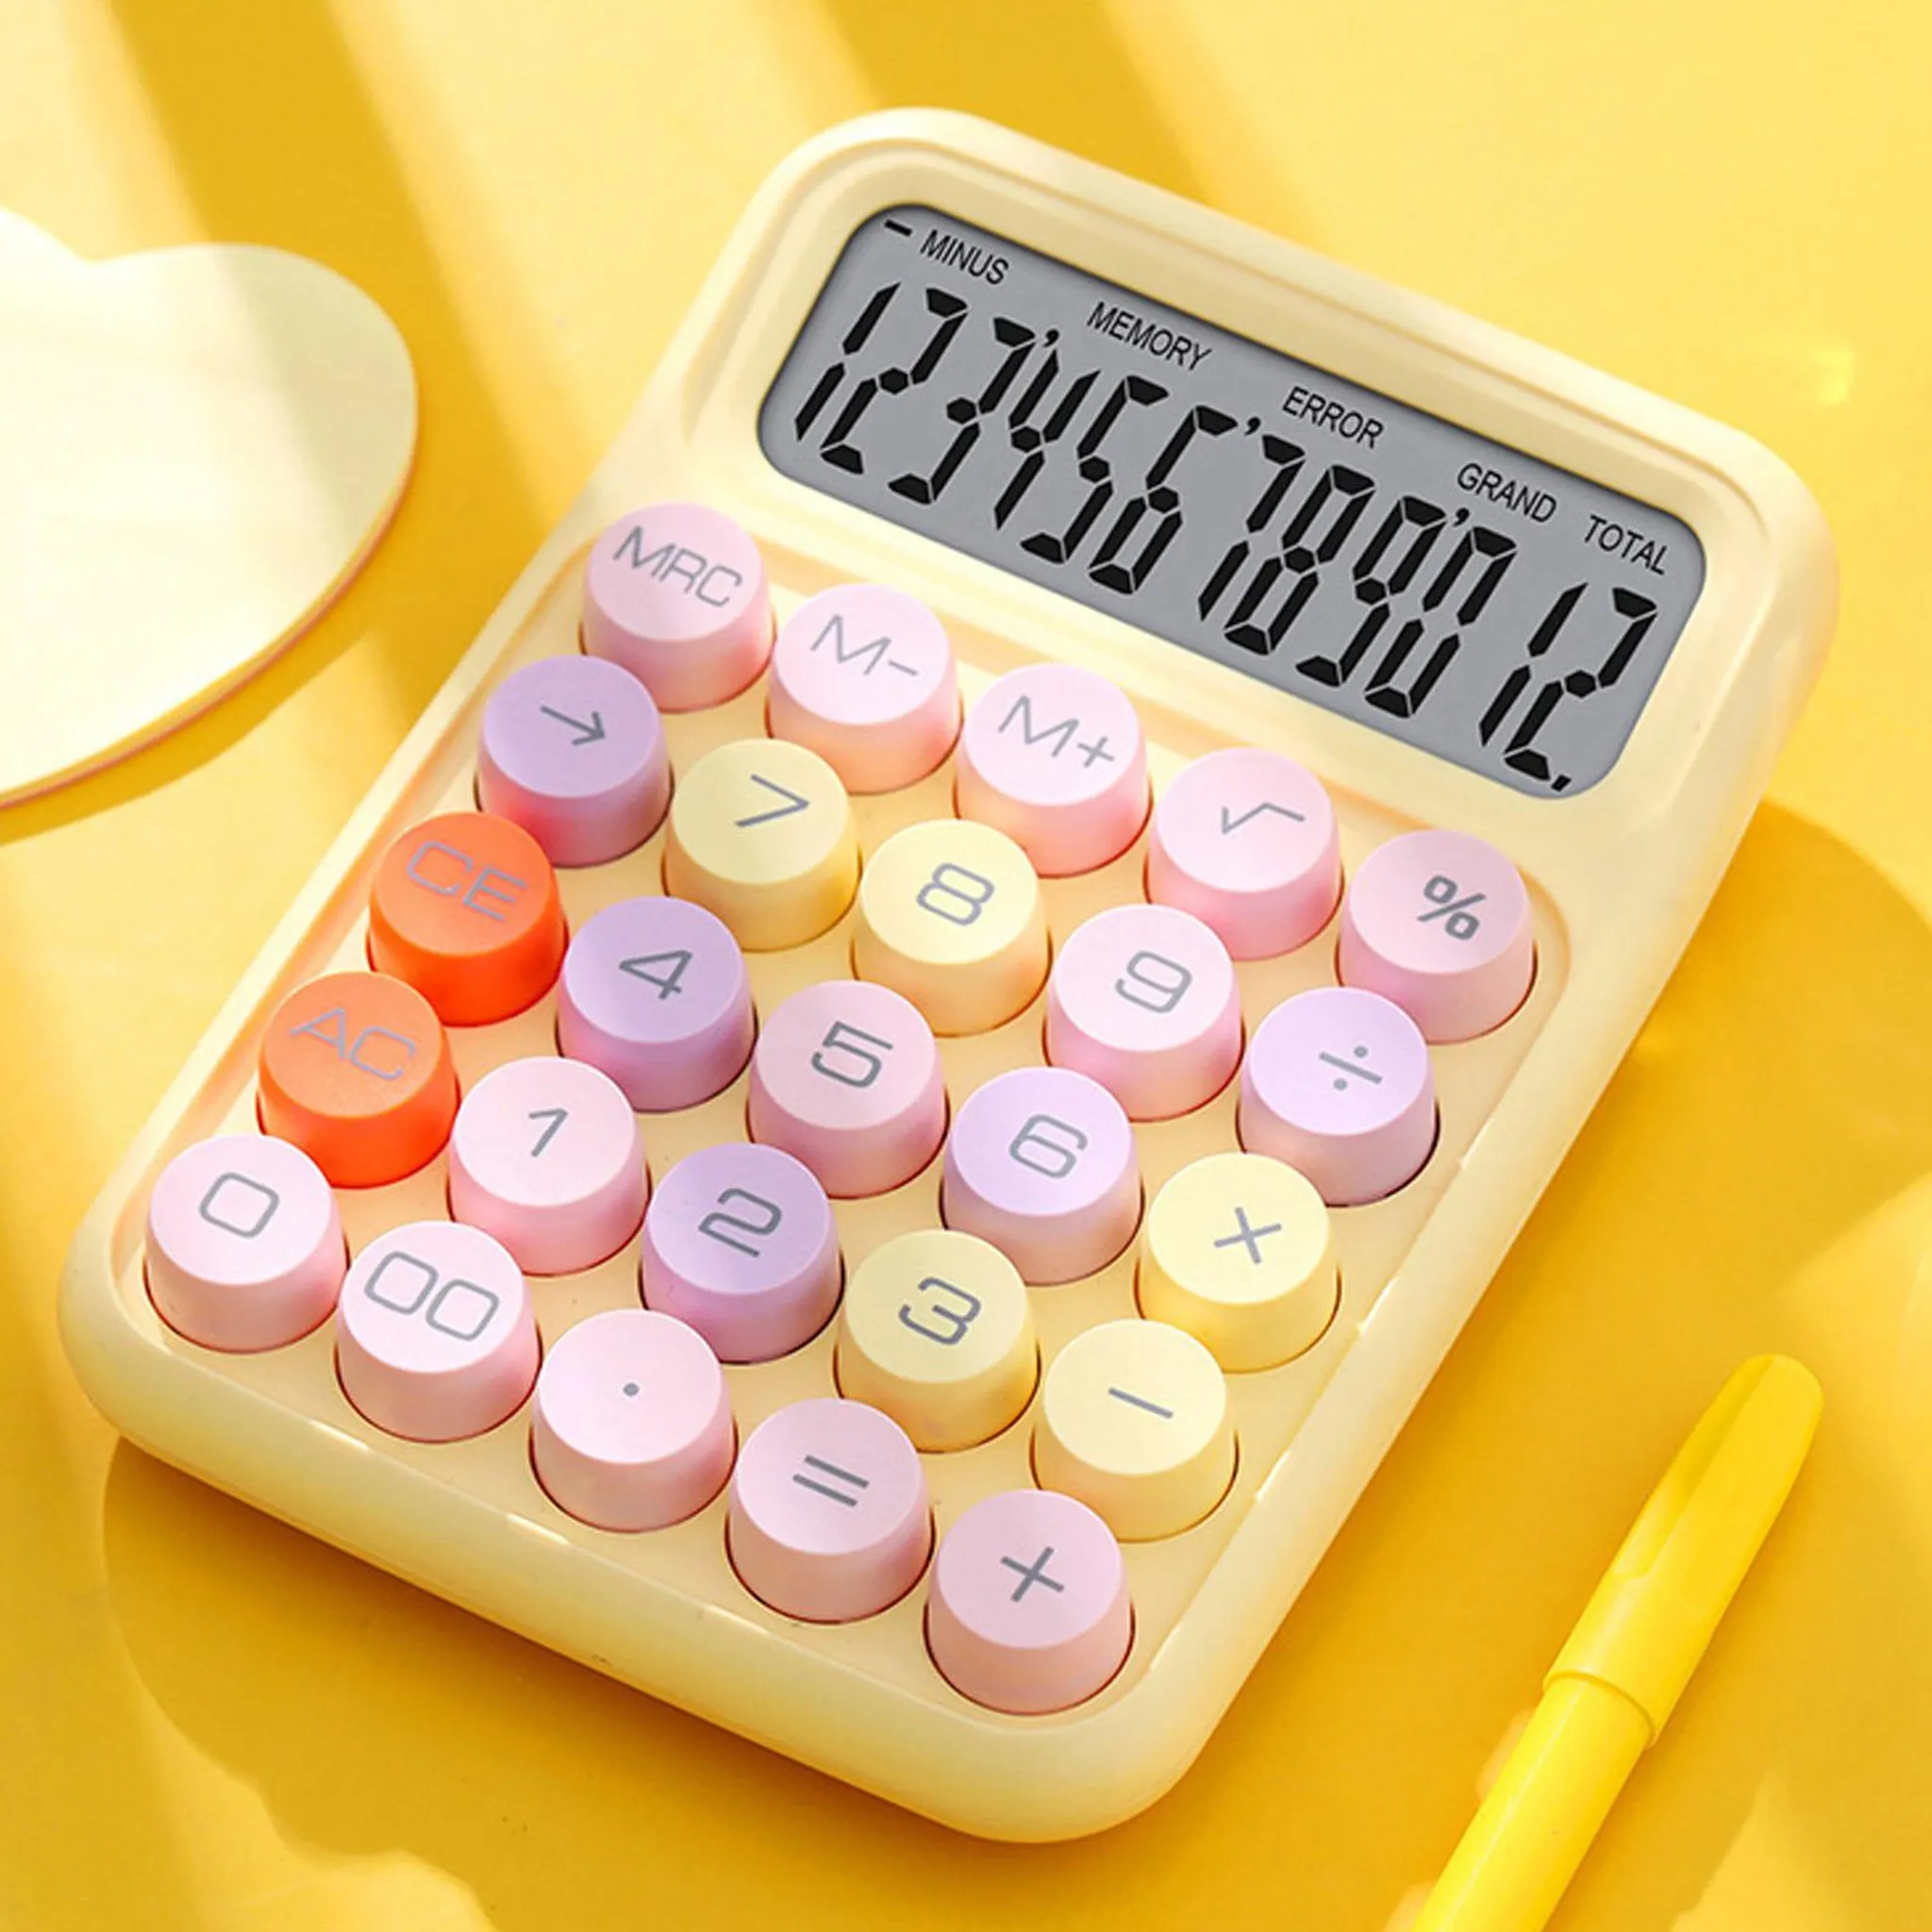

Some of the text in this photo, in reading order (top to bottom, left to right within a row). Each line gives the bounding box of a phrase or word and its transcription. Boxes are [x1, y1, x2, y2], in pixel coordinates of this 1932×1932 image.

[921, 229, 1009, 285] MINUS
[1087, 302, 1211, 372] MEMORY
[1282, 386, 1384, 450] ERROR
[1456, 461, 1667, 575] GRAND TOTAL
[612, 525, 741, 607] MRC
[999, 695, 1114, 767] M+
[734, 774, 809, 828] 7
[407, 841, 525, 920] CE
[916, 863, 994, 925] 8
[1417, 875, 1487, 941] %
[619, 950, 692, 1000] 4
[1115, 951, 1191, 1013] 9
[291, 1008, 415, 1079] AC
[810, 1021, 893, 1089] 5
[528, 1108, 568, 1158] 1
[1009, 1115, 1088, 1178] 6
[698, 1189, 782, 1257] 2
[898, 1277, 981, 1345] 3
